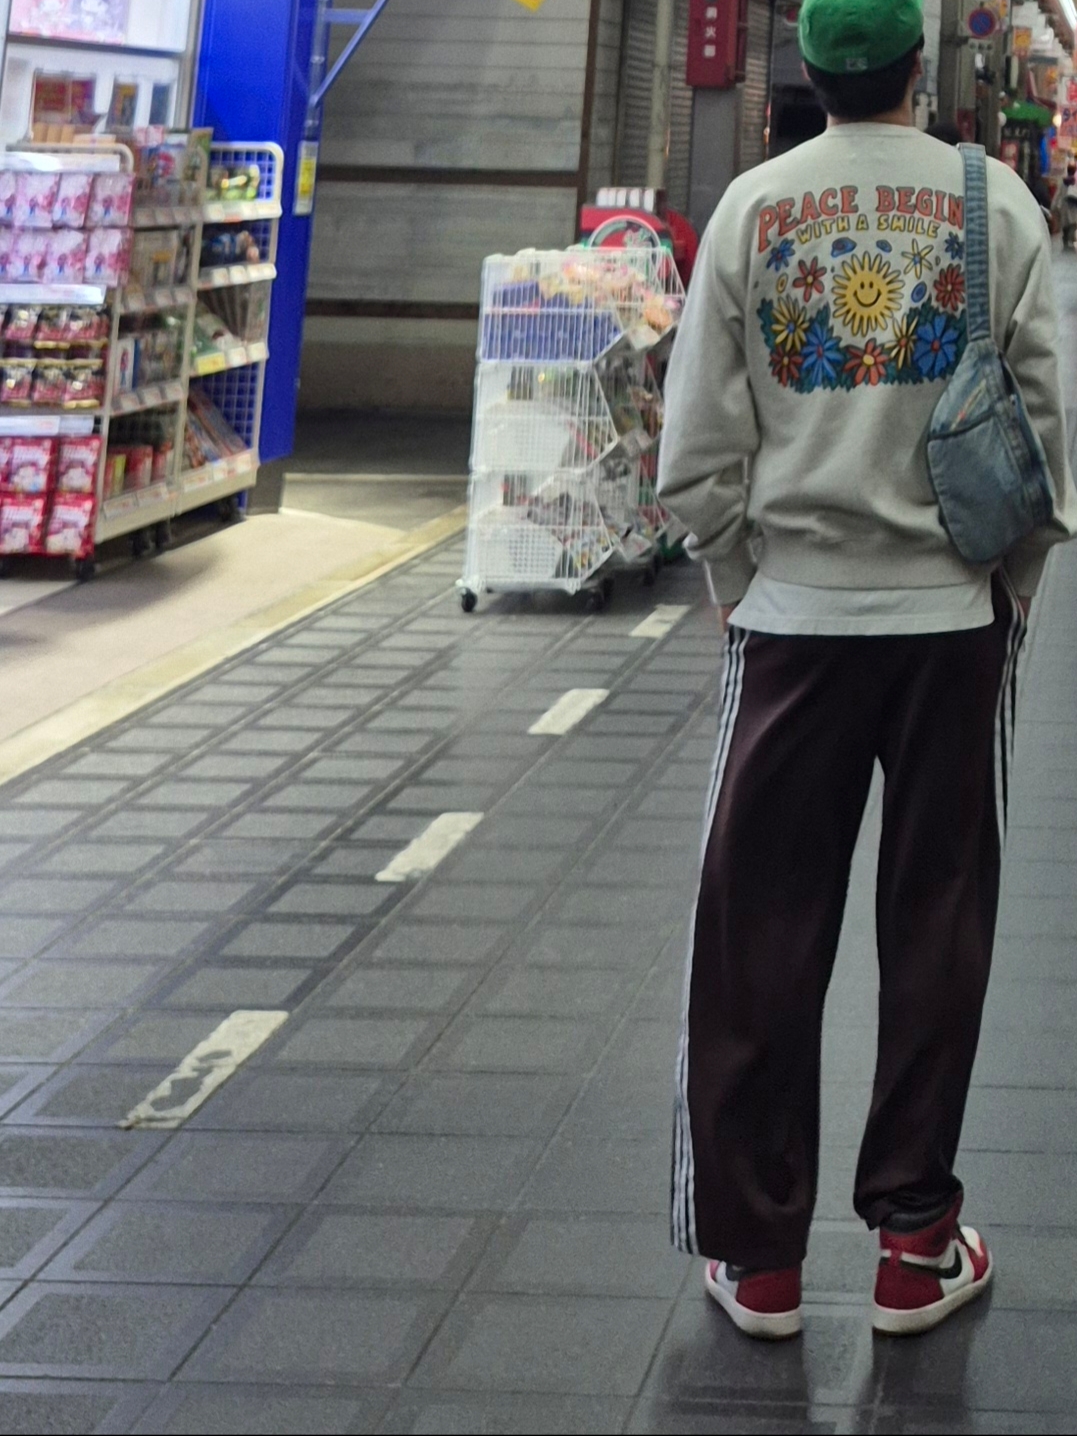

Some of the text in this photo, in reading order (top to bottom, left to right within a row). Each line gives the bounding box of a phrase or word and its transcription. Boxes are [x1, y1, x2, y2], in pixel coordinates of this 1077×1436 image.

[758, 185, 859, 254] PEACE
[796, 214, 941, 245] WITH A SMILE
